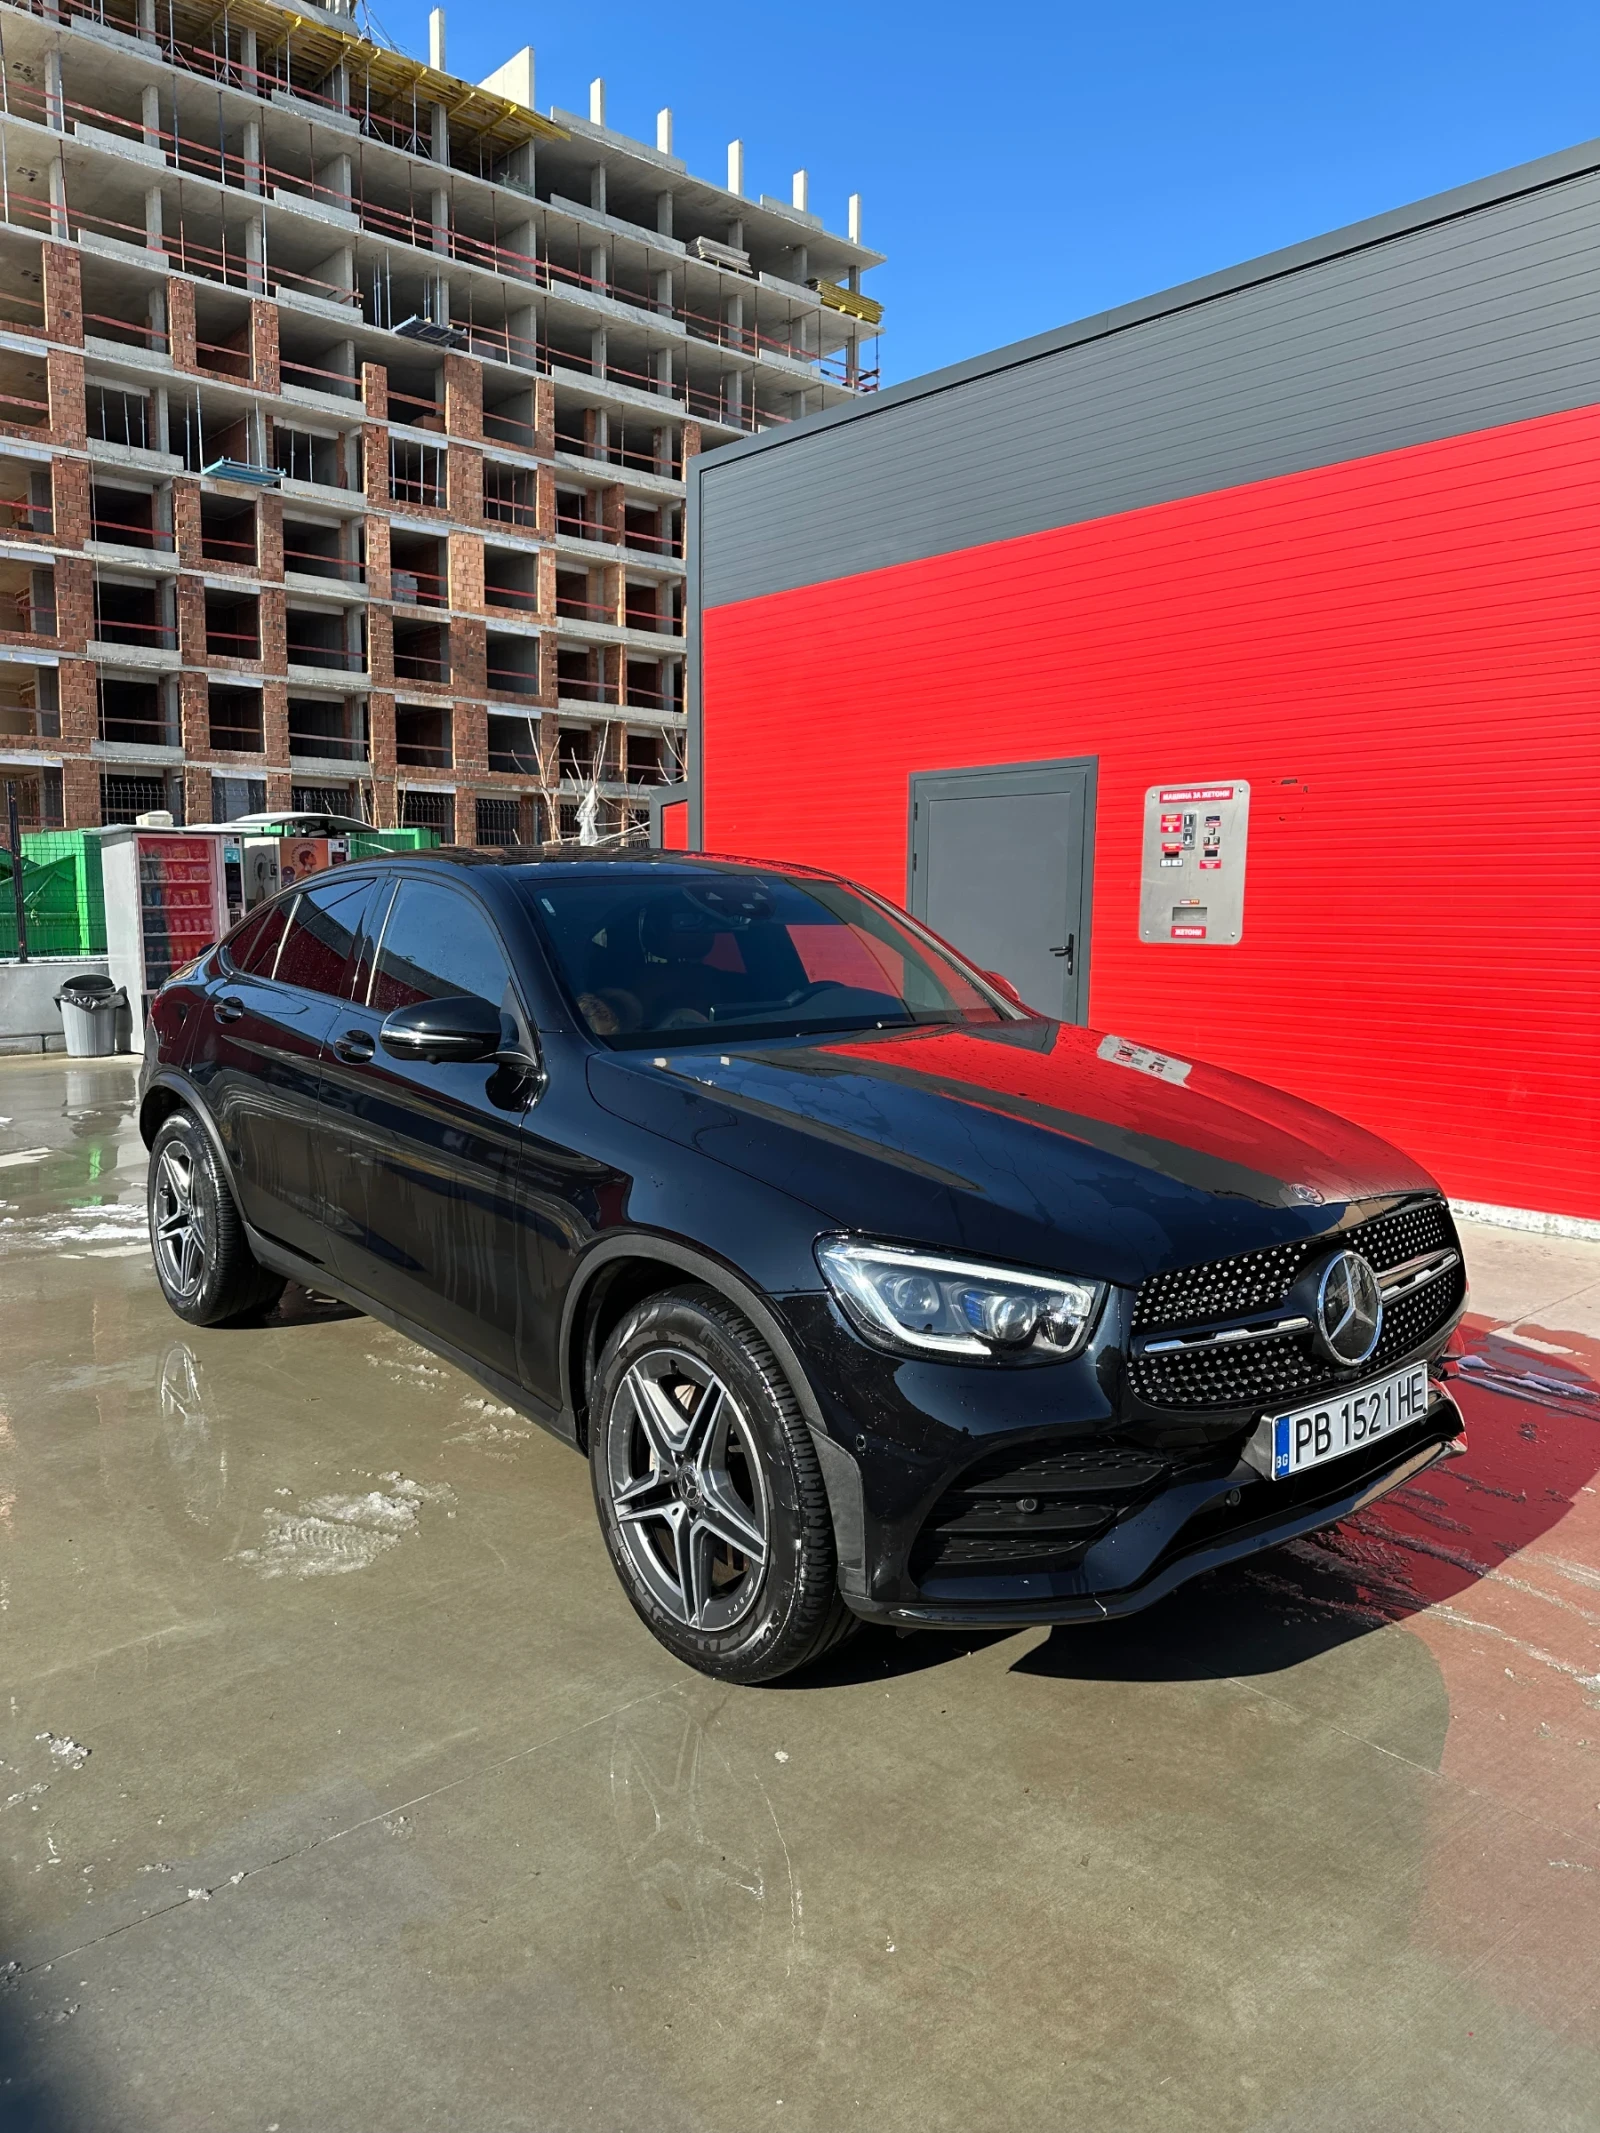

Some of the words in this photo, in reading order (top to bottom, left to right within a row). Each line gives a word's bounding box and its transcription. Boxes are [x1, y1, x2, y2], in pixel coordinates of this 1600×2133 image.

[1163, 792, 1192, 801] МАШИНА
[1175, 928, 1202, 936] ЖЕТОНИ
[1295, 1412, 1331, 1464] PB
[1340, 1386, 1391, 1447] 1521
[1397, 1371, 1424, 1421] HE
[1276, 1454, 1288, 1468] BG
